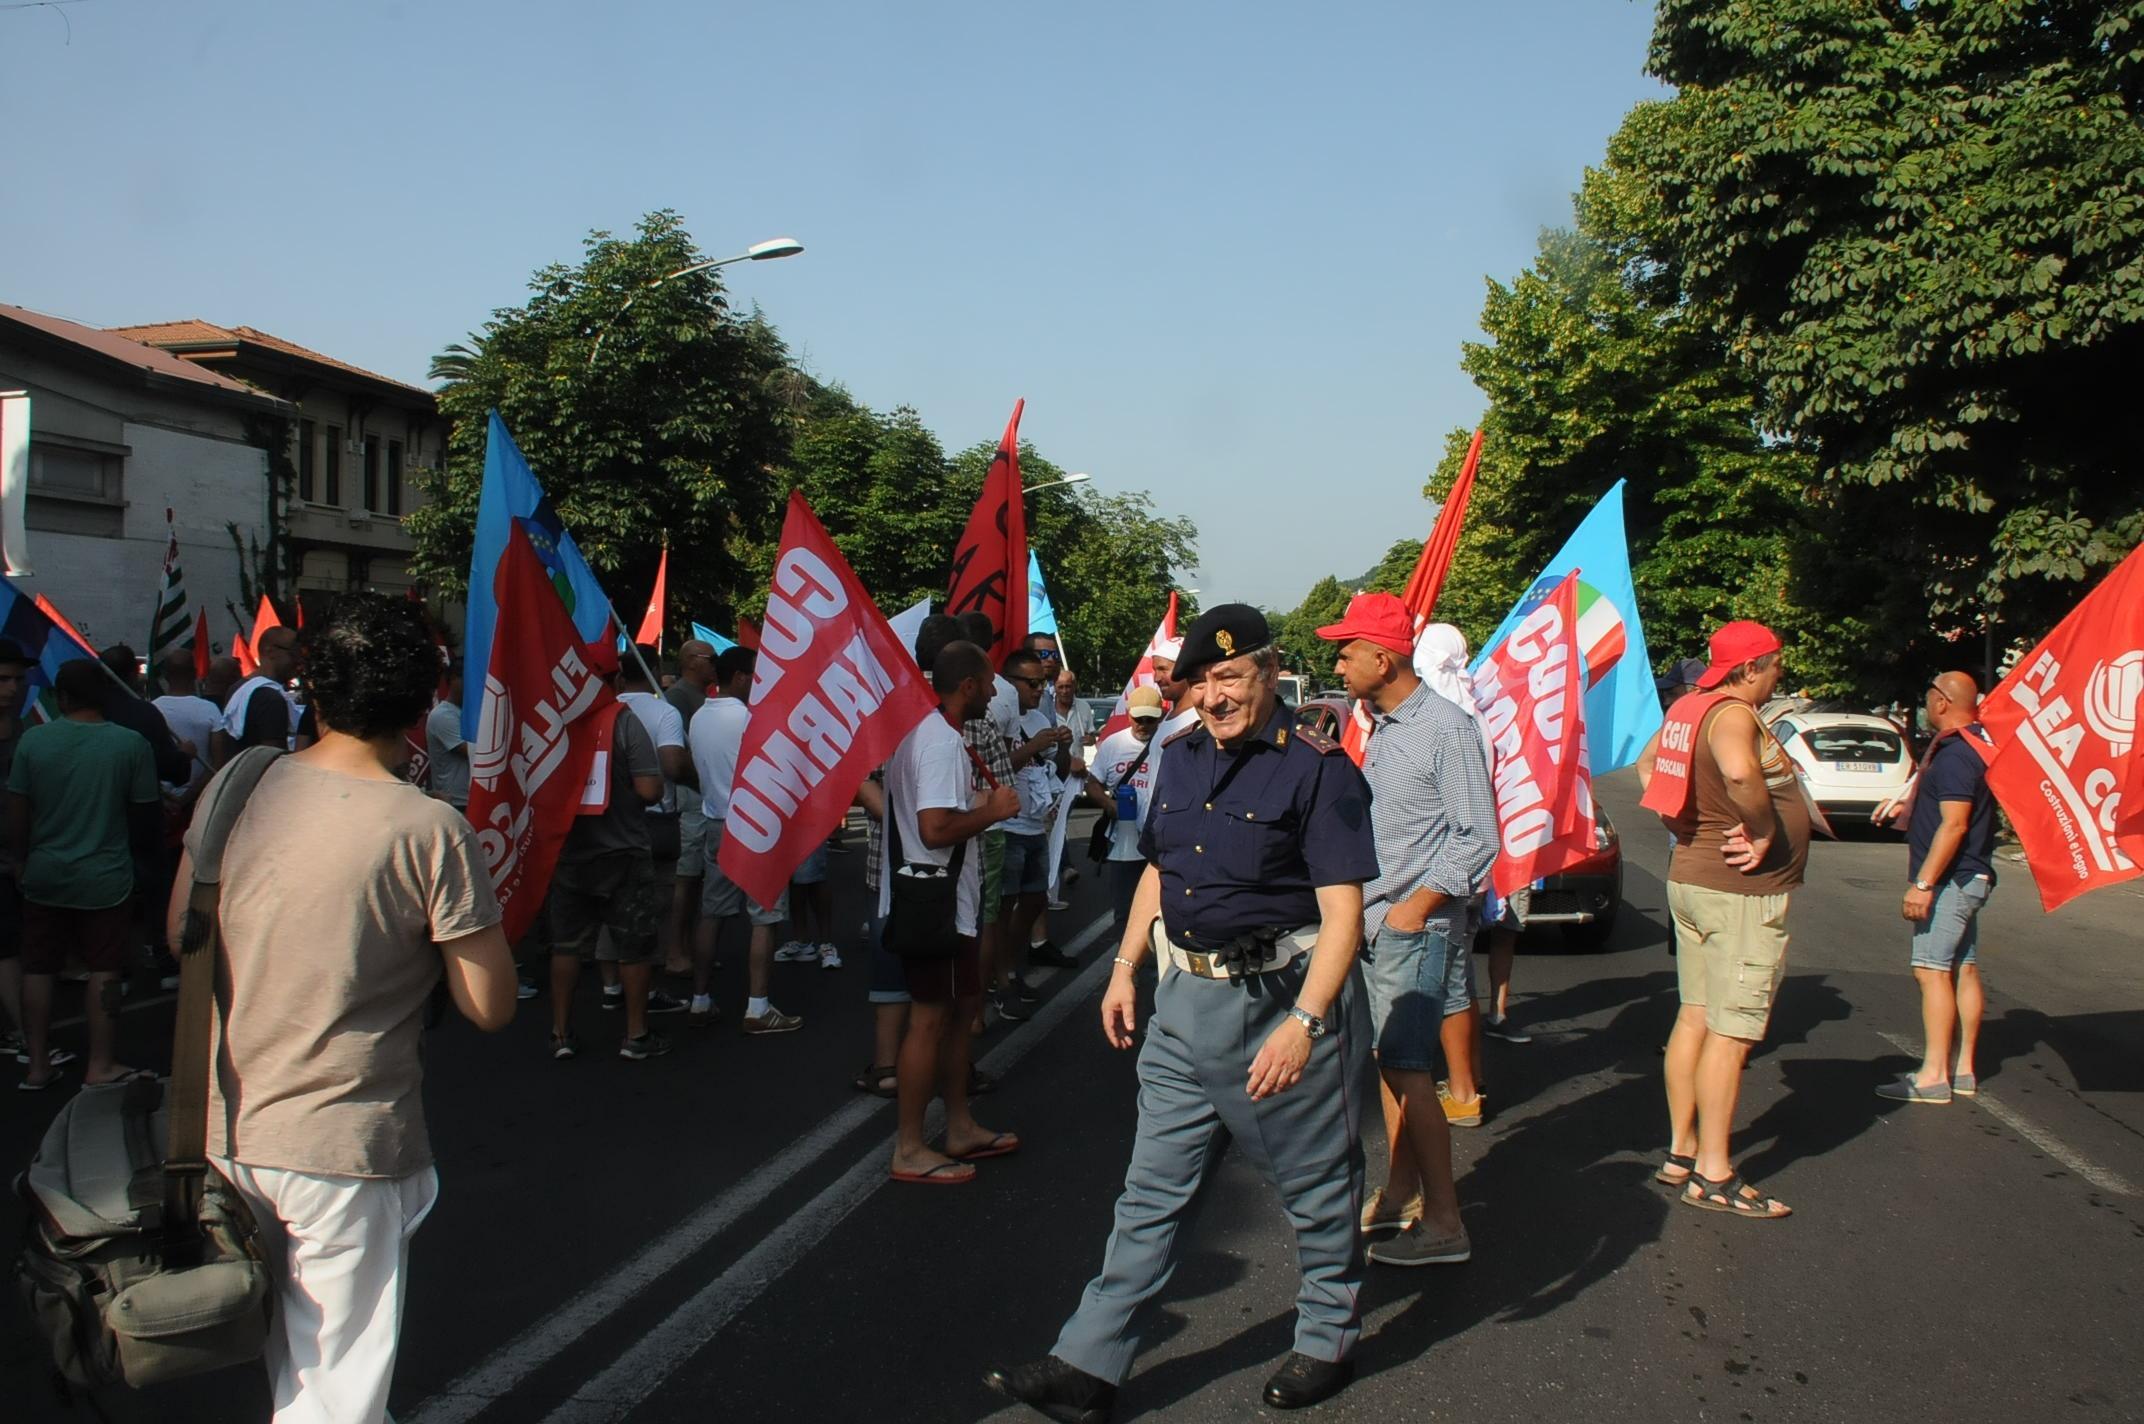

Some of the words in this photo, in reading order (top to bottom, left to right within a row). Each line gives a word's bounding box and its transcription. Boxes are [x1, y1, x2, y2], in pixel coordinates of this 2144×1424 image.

[1661, 720, 1692, 752] CGIL
[1655, 757, 1686, 778] TOSCANA
[2040, 779, 2079, 842] Costruzioni
[2069, 842, 2080, 850] e
[2071, 848, 2089, 880] Legno
